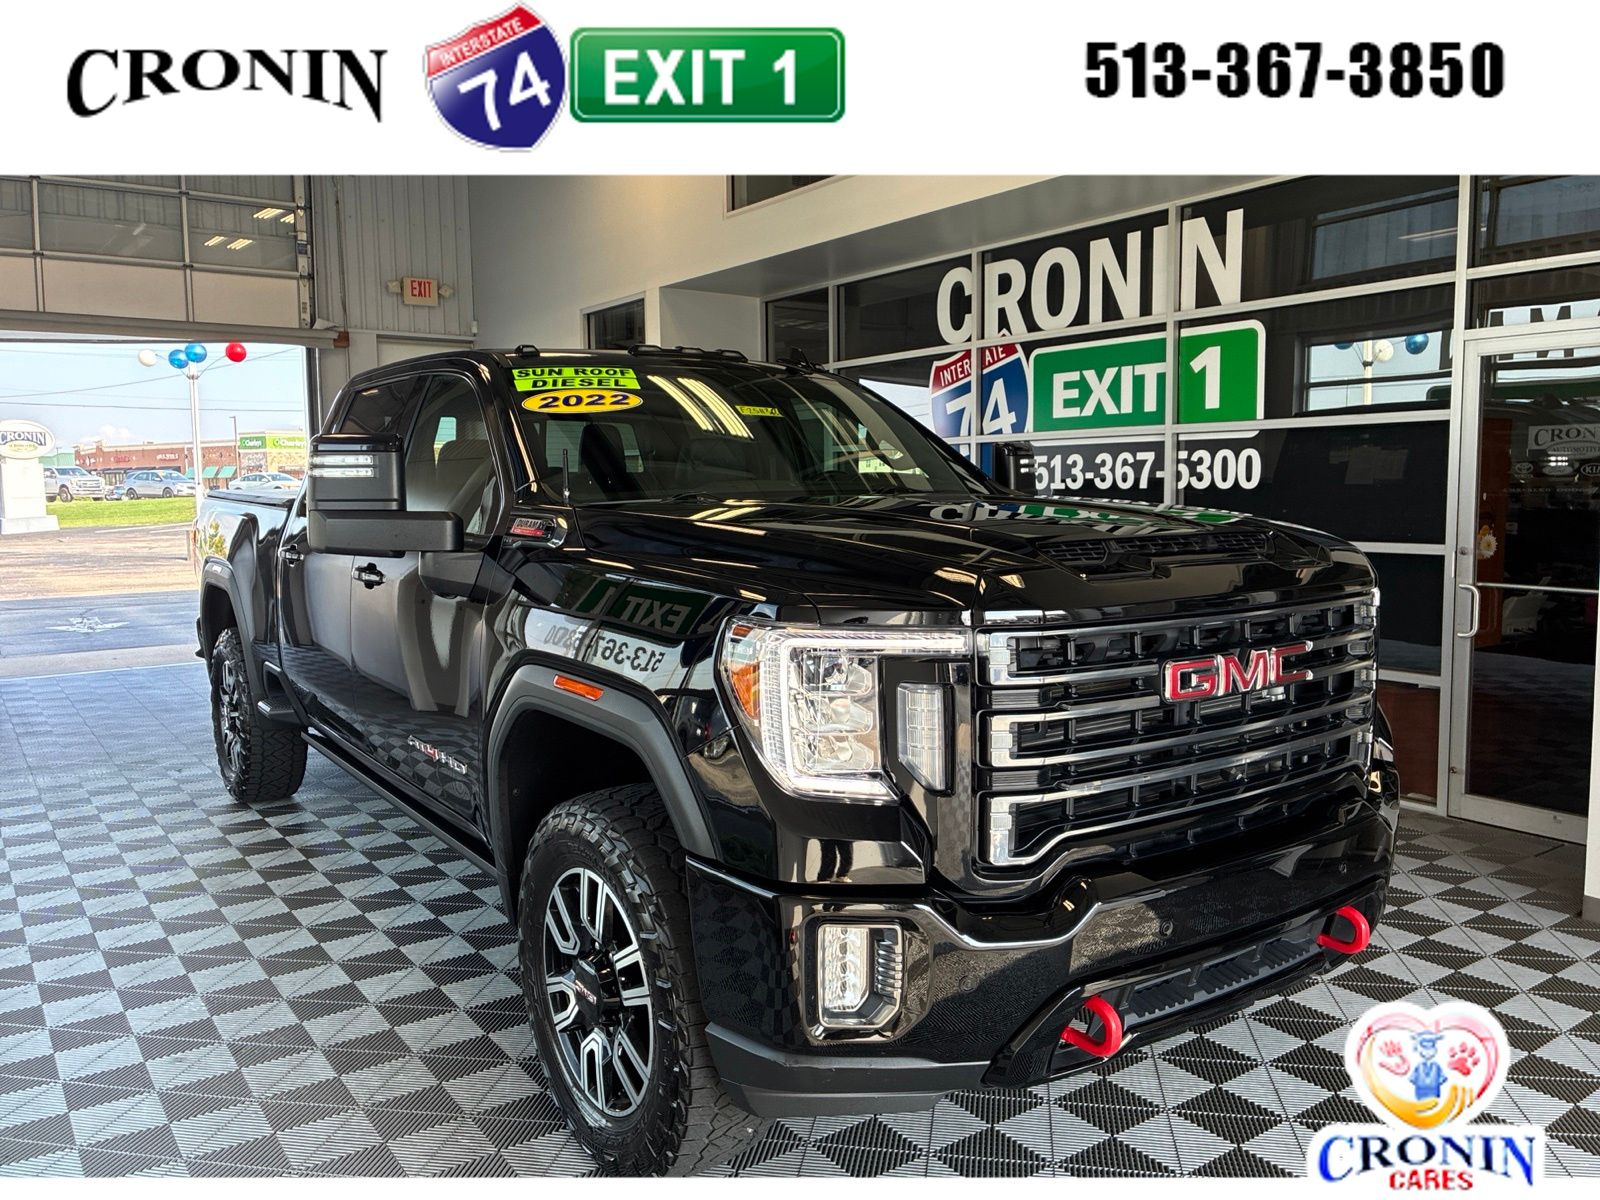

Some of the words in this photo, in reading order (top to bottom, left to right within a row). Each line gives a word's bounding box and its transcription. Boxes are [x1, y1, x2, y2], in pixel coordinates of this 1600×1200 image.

[410, 279, 432, 298] EXIT
[937, 208, 1244, 345] CRONIN
[517, 367, 563, 378] SUN
[573, 367, 632, 377] ROOF
[940, 346, 1007, 387] INTERATE
[531, 378, 628, 389] DIESEL
[1052, 362, 1167, 419] EXIT
[1189, 346, 1222, 410] 1
[538, 394, 631, 410] 2022
[0, 431, 47, 447] CRONIN
[1034, 448, 1262, 491] 513-367-5300
[1164, 640, 1314, 702] GMC
